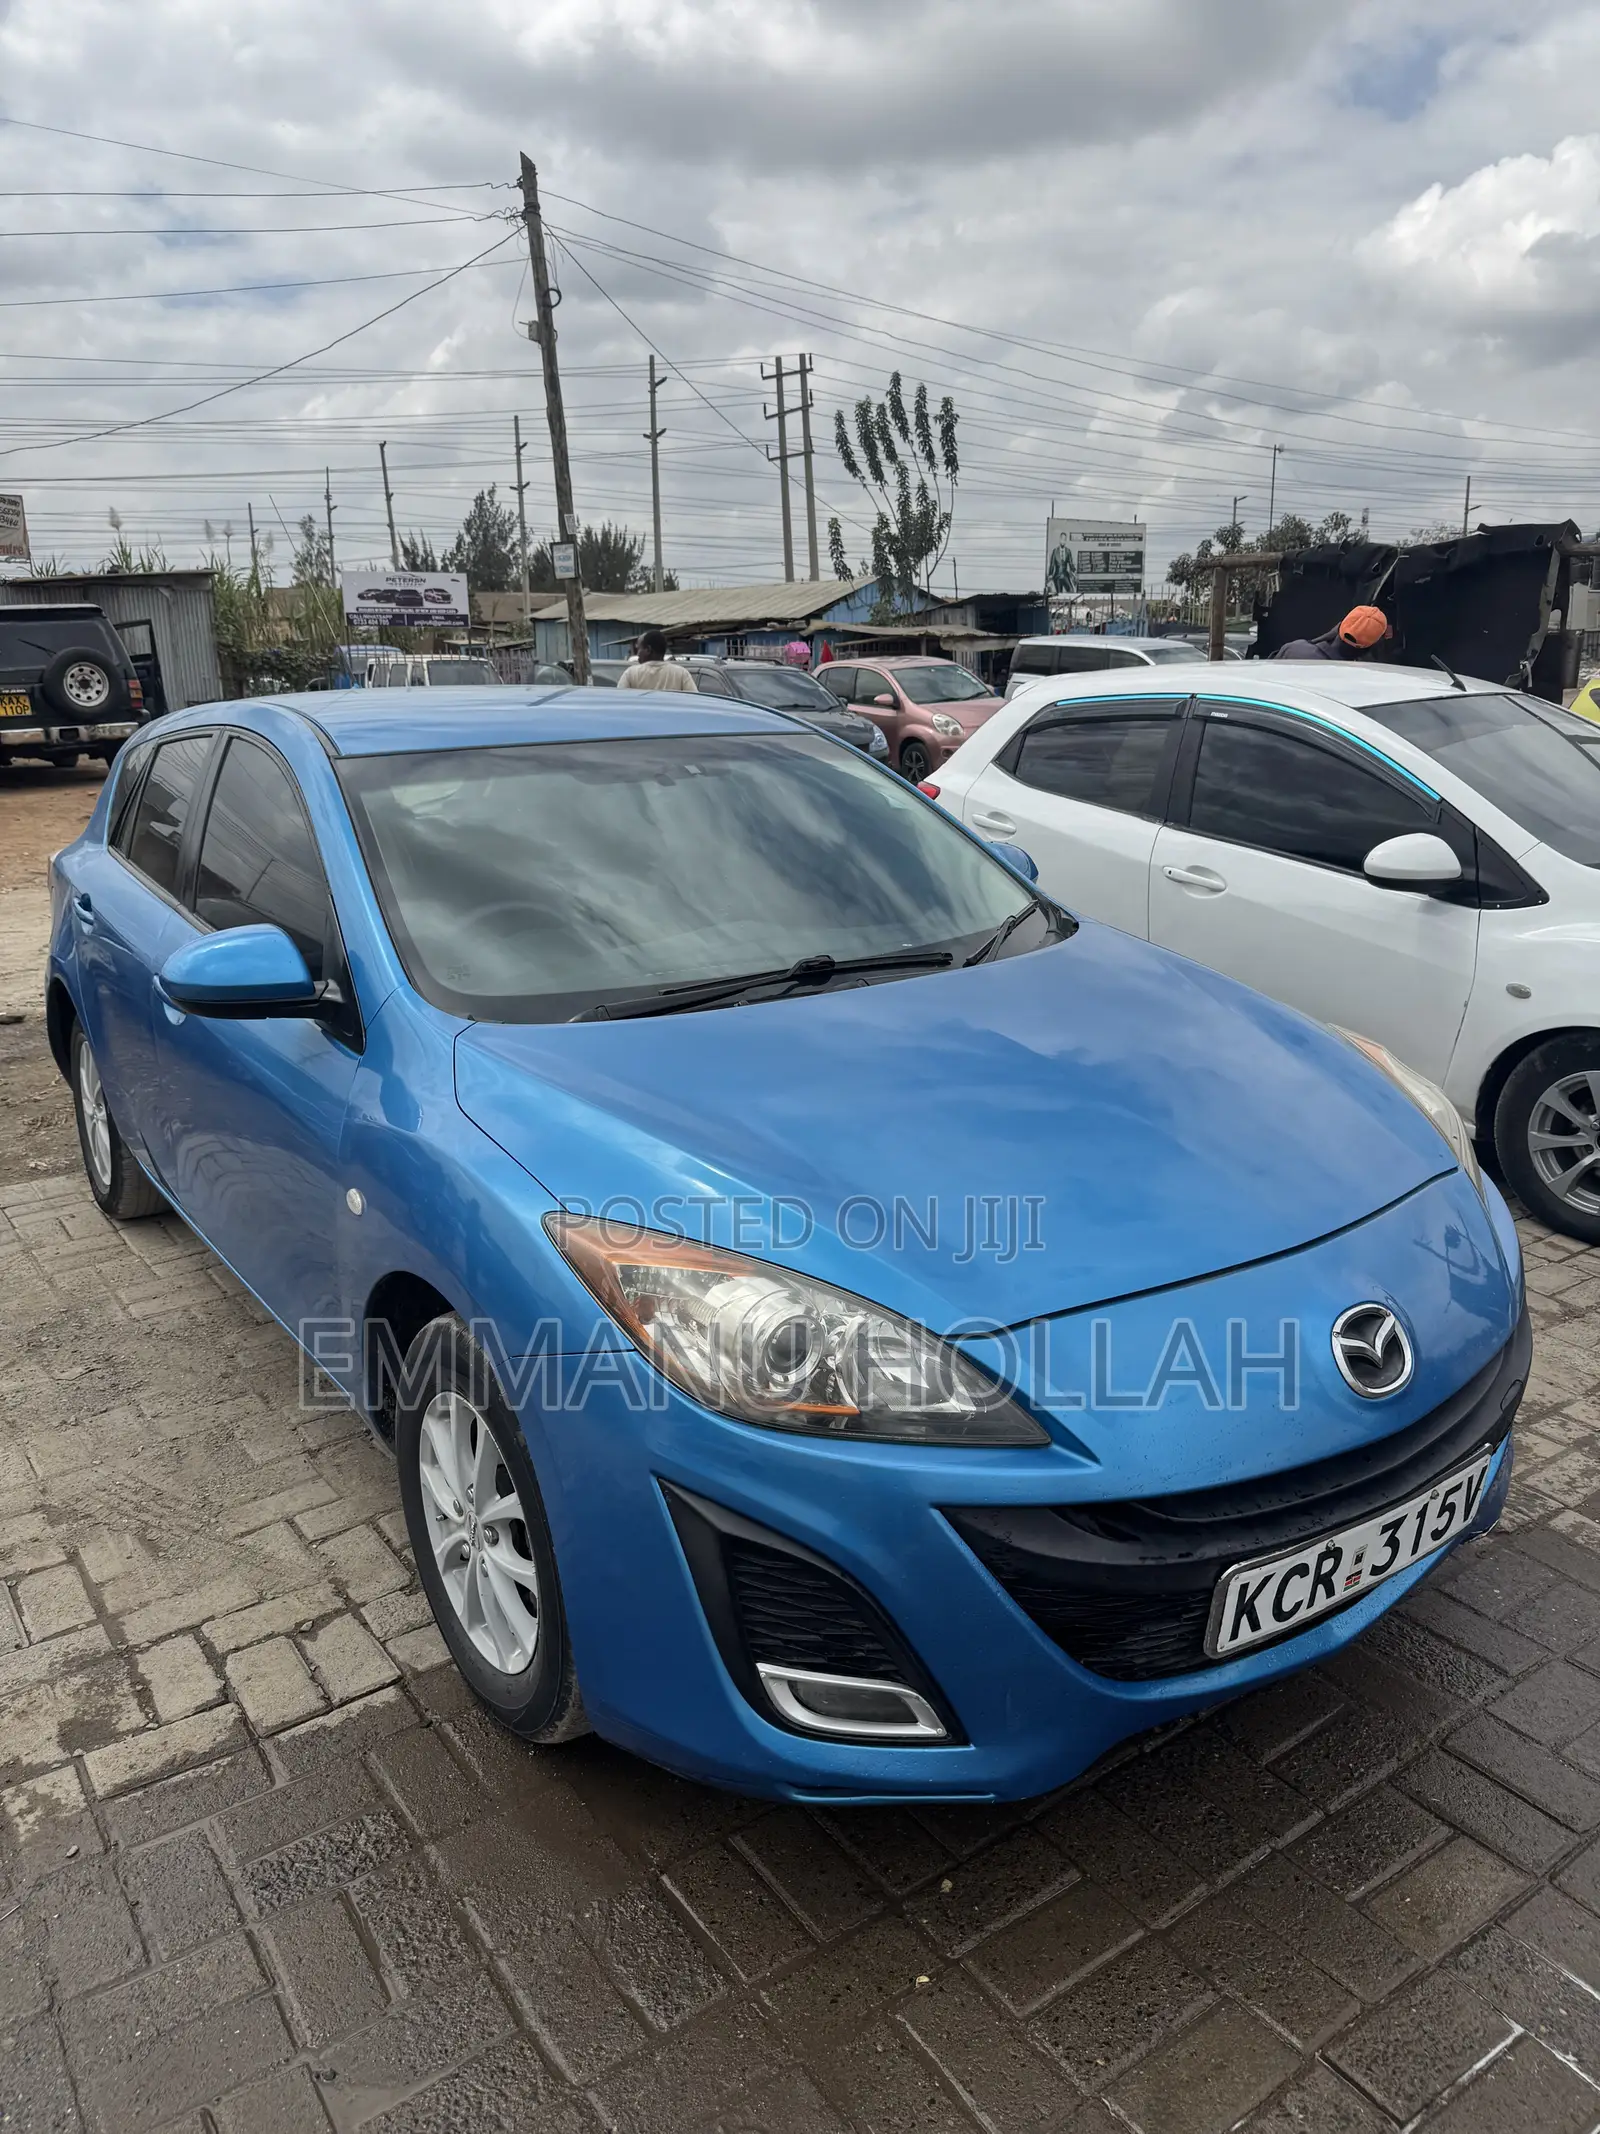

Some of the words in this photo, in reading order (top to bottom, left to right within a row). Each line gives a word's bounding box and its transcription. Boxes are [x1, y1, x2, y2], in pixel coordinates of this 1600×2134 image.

[4, 704, 30, 716] 110P
[1229, 1546, 1344, 1642] KCR
[1369, 1464, 1489, 1578] 315V
